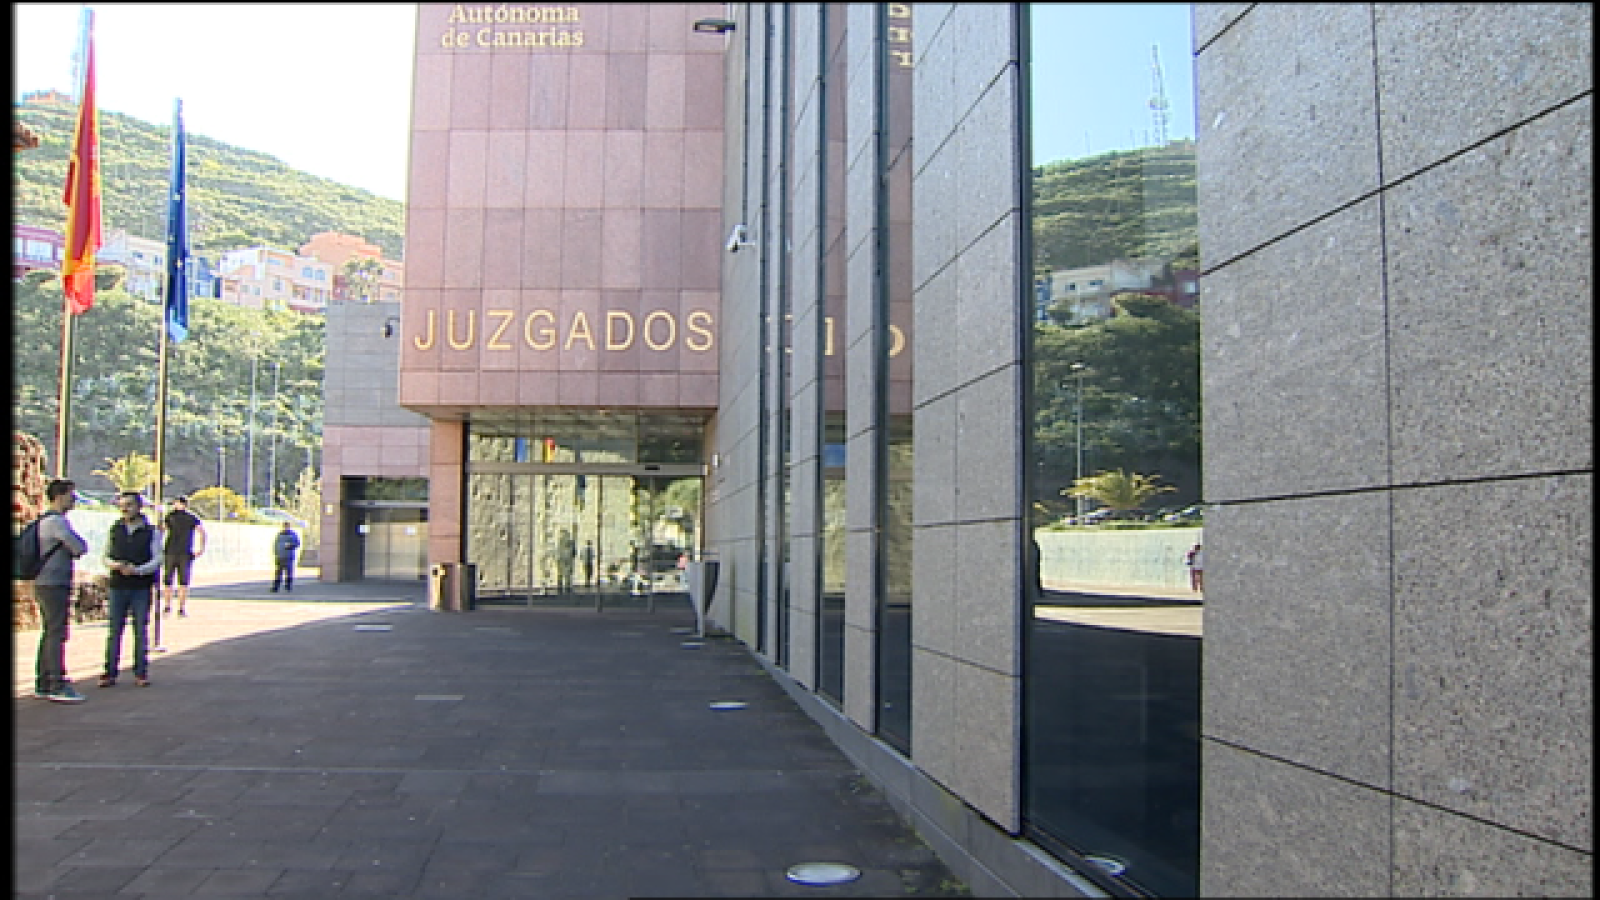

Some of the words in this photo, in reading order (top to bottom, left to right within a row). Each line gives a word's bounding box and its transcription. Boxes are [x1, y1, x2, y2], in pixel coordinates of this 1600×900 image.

[448, 4, 580, 23] Autónoma
[441, 27, 470, 47] de
[476, 27, 584, 47] Canarias
[414, 309, 714, 351] JUZGADOS
